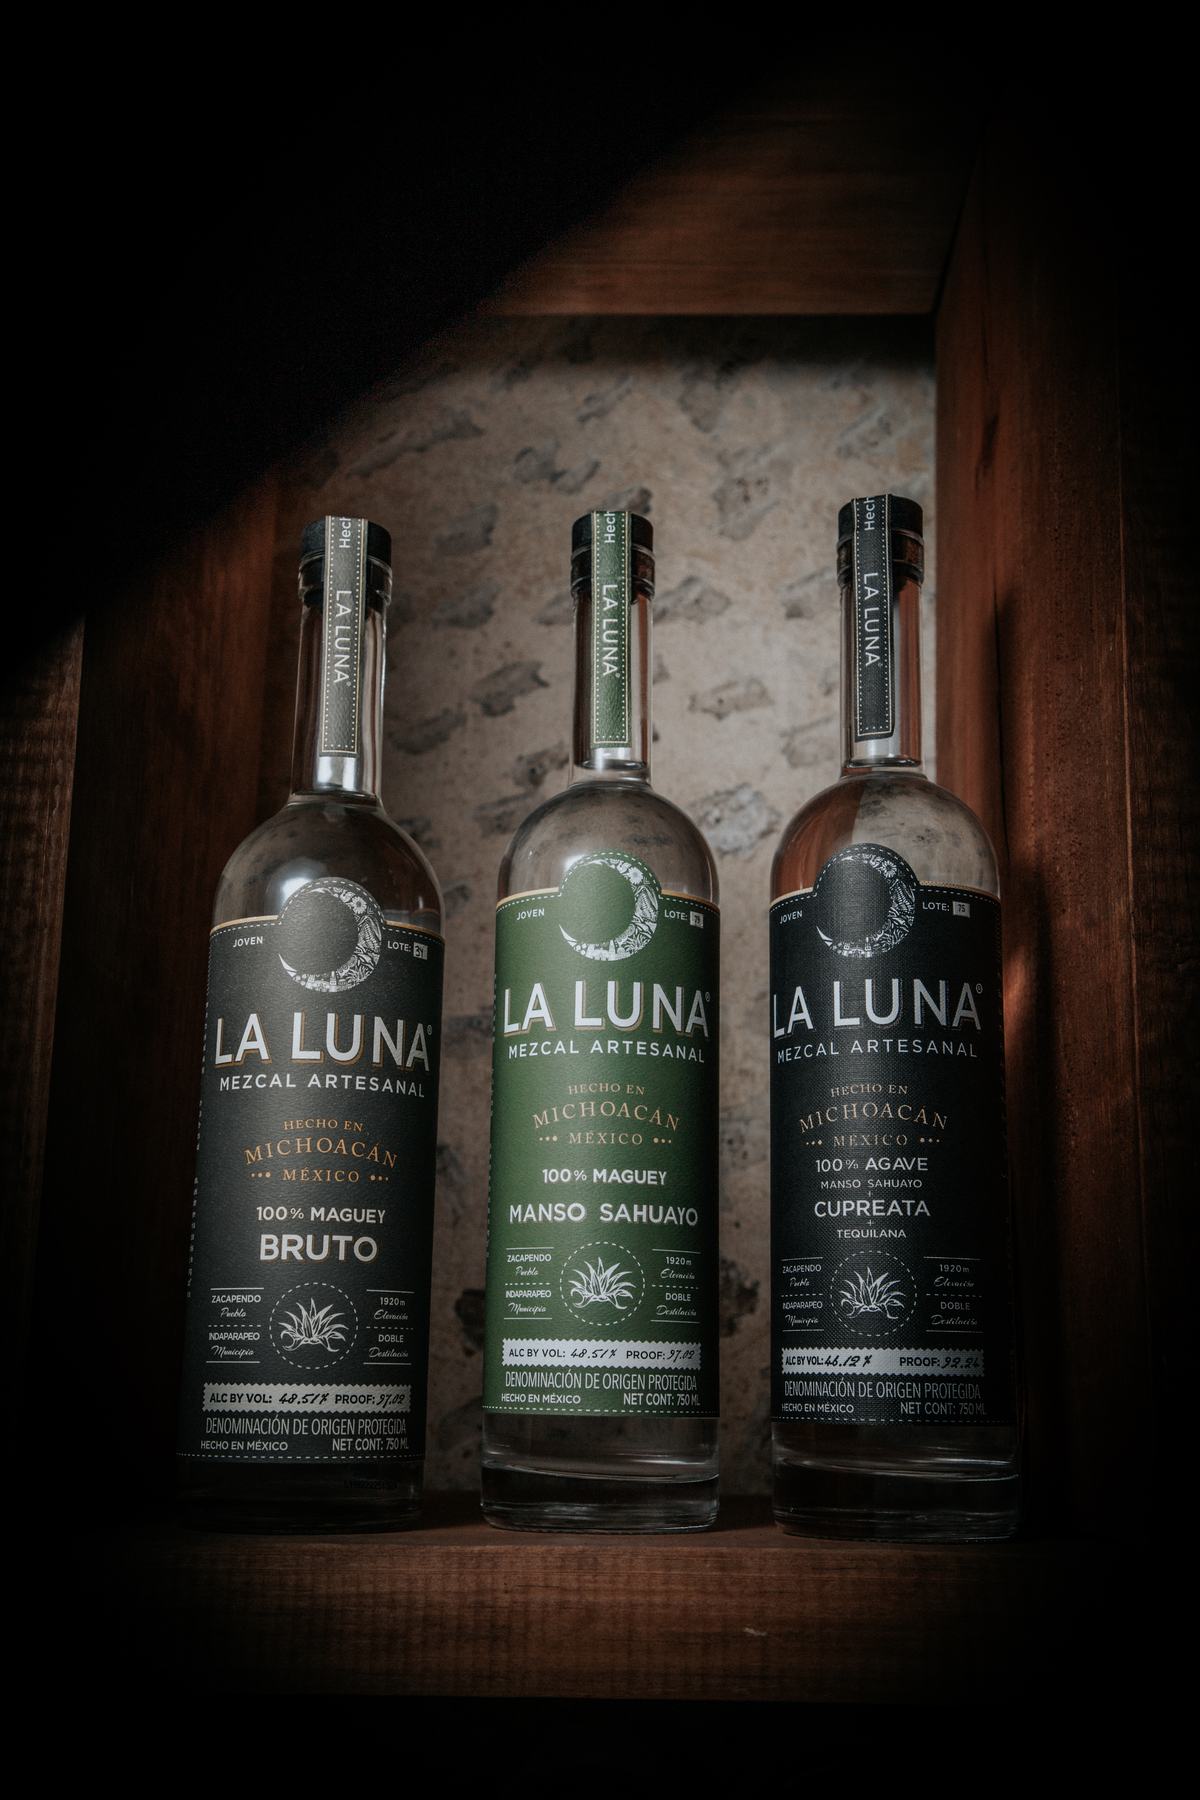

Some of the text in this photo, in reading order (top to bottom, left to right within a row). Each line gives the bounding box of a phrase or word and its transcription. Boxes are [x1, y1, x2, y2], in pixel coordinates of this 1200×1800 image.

[864, 572, 879, 600] LA
[336, 590, 352, 617] LA
[603, 584, 618, 611] LA
[922, 901, 950, 912] LOTE:
[517, 908, 545, 921] JOVEN
[779, 910, 803, 925] JOVEN
[233, 936, 263, 948] JOVEN
[388, 940, 411, 952] LOTE:
[503, 982, 556, 1034] LA
[773, 986, 814, 1039] LA
[214, 1013, 270, 1066] LA
[508, 1040, 705, 1063] MEZCAL ARTESANAL
[777, 1039, 978, 1064] MEZCAL ARTESANAL
[220, 1074, 425, 1098] MEZCAL ARTESANAL
[568, 1083, 646, 1096] HECHO EN
[830, 1084, 909, 1098] HECHO EN
[532, 1101, 680, 1132] MICHOACÁN
[800, 1102, 948, 1133] MICHOACÁN
[284, 1119, 364, 1132] HECHO EN
[244, 1137, 398, 1169] MICHOACÁN
[865, 1157, 929, 1171] AGAVE
[283, 1167, 360, 1183] MÉXICO
[593, 1169, 667, 1186] MAGUEY
[820, 1179, 923, 1189] MANSO SAHUAYO
[310, 1207, 386, 1224] MAGUEY
[509, 1203, 699, 1226] MANSO SAHUAYO
[814, 1200, 932, 1217] CUPREATA
[837, 1229, 907, 1239] TEQUILANA
[260, 1234, 378, 1262] BRUTO
[506, 1254, 552, 1263] ZACAPENDO
[782, 1264, 822, 1274] ZACAPENDO
[212, 1295, 261, 1303] ZACAPENDO
[665, 1292, 692, 1301] DOBLE
[940, 1301, 970, 1311] DOBLE
[378, 1334, 405, 1343] DOBLE
[509, 1348, 525, 1357] ALC
[527, 1348, 539, 1357] BY
[542, 1349, 566, 1358] VOL:
[626, 1350, 666, 1360] PROOF:
[785, 1356, 797, 1365] ALC
[797, 1356, 806, 1365] BY
[806, 1356, 824, 1365] VOL:
[899, 1357, 940, 1367] PROOF:
[505, 1368, 698, 1391] DENOMINACIÓN DE ORIGEN PROTEGIDA
[785, 1377, 981, 1399] DENOMINACIÓN DE ORIGEN PROTEGIDA
[209, 1393, 228, 1403] ALC
[230, 1393, 244, 1403] BY
[246, 1393, 272, 1403] VOL:
[335, 1394, 375, 1404] PROOF:
[501, 1392, 582, 1404] HECHO EN MÉXICO
[623, 1393, 644, 1406] NET
[645, 1393, 675, 1406] CONT:
[676, 1394, 690, 1406] 750
[781, 1402, 855, 1413] HECHO EN MÉXICO
[900, 1402, 921, 1415] NET
[959, 1403, 974, 1415] 750
[206, 1414, 407, 1435] DENOMINACIÓN DE ORIGEN PROTEGIDA
[200, 1439, 289, 1451] HECHO EN MÉXICO
[332, 1438, 354, 1451] NET
[354, 1438, 384, 1451] CONT:
[385, 1438, 399, 1451] 750
